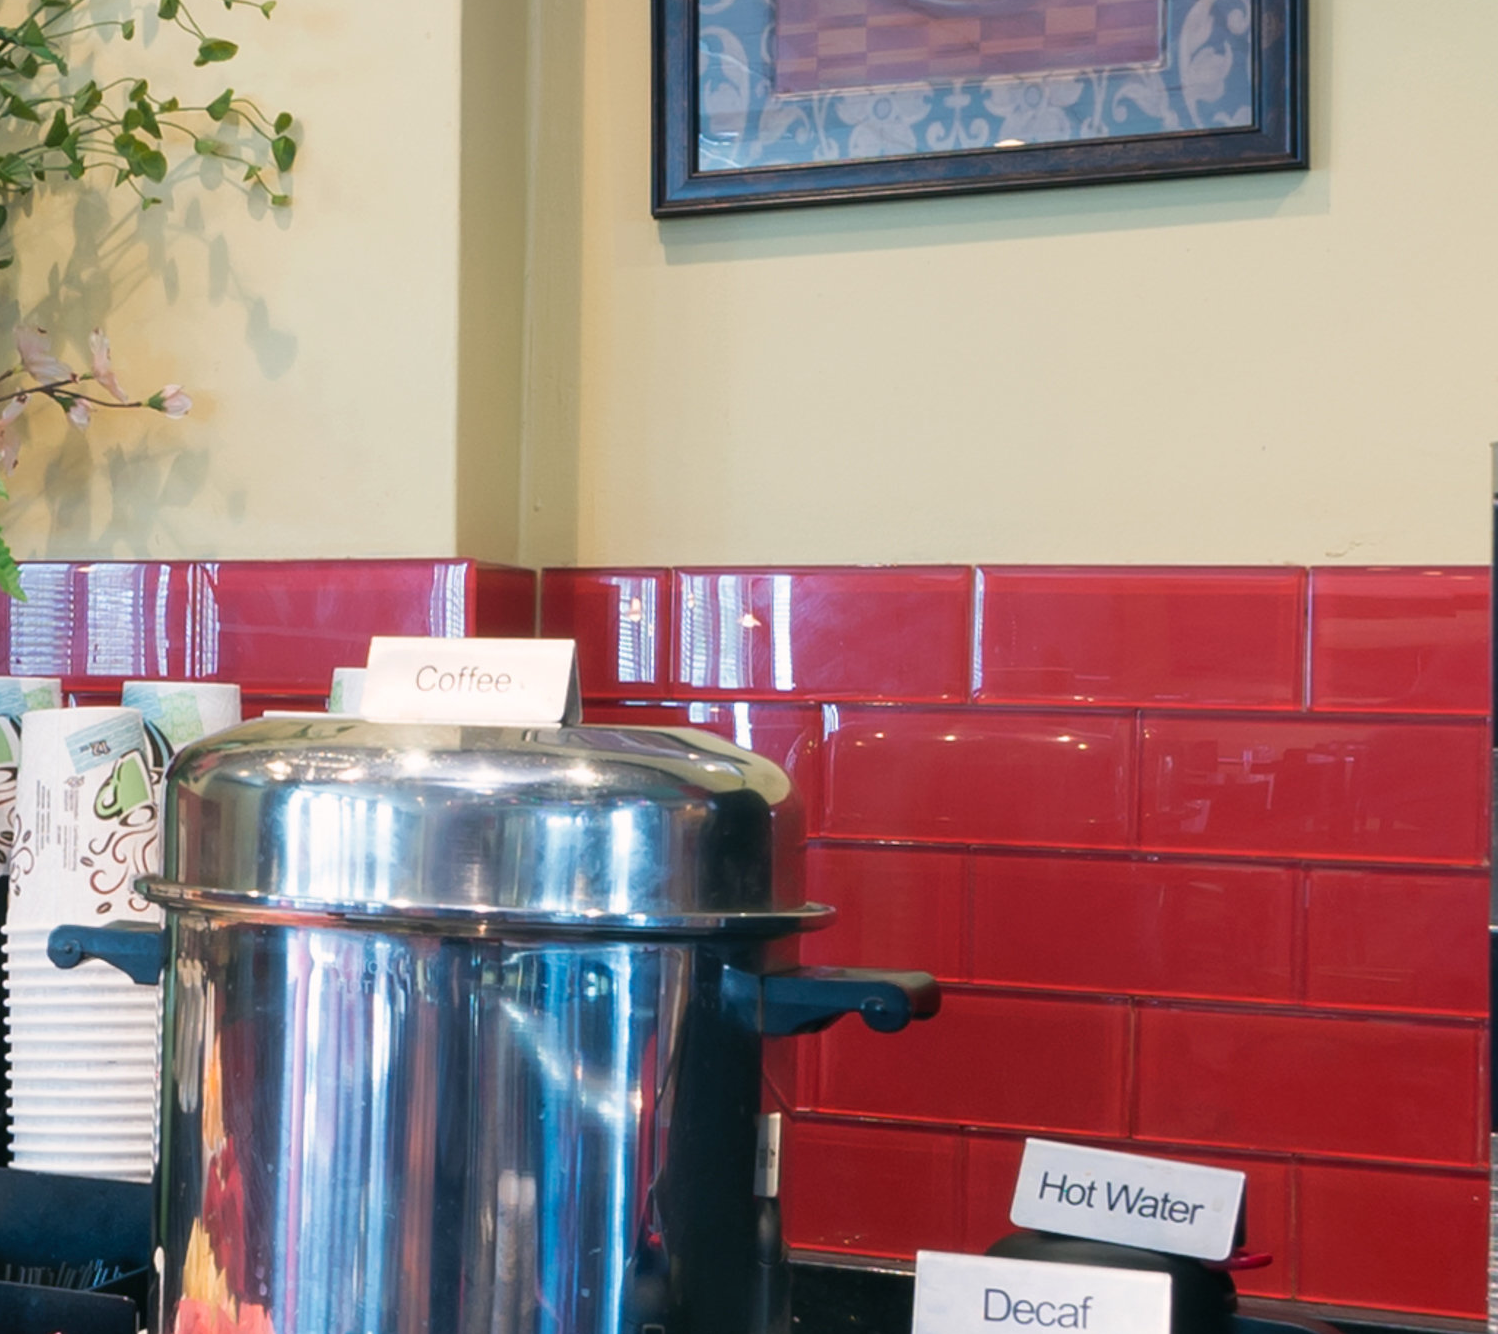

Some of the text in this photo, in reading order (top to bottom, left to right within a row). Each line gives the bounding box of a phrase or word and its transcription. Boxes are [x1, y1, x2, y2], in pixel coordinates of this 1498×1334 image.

[416, 665, 511, 692] Coffee
[1039, 1171, 1204, 1225] Hot Water
[984, 1287, 1094, 1329] Decaf
